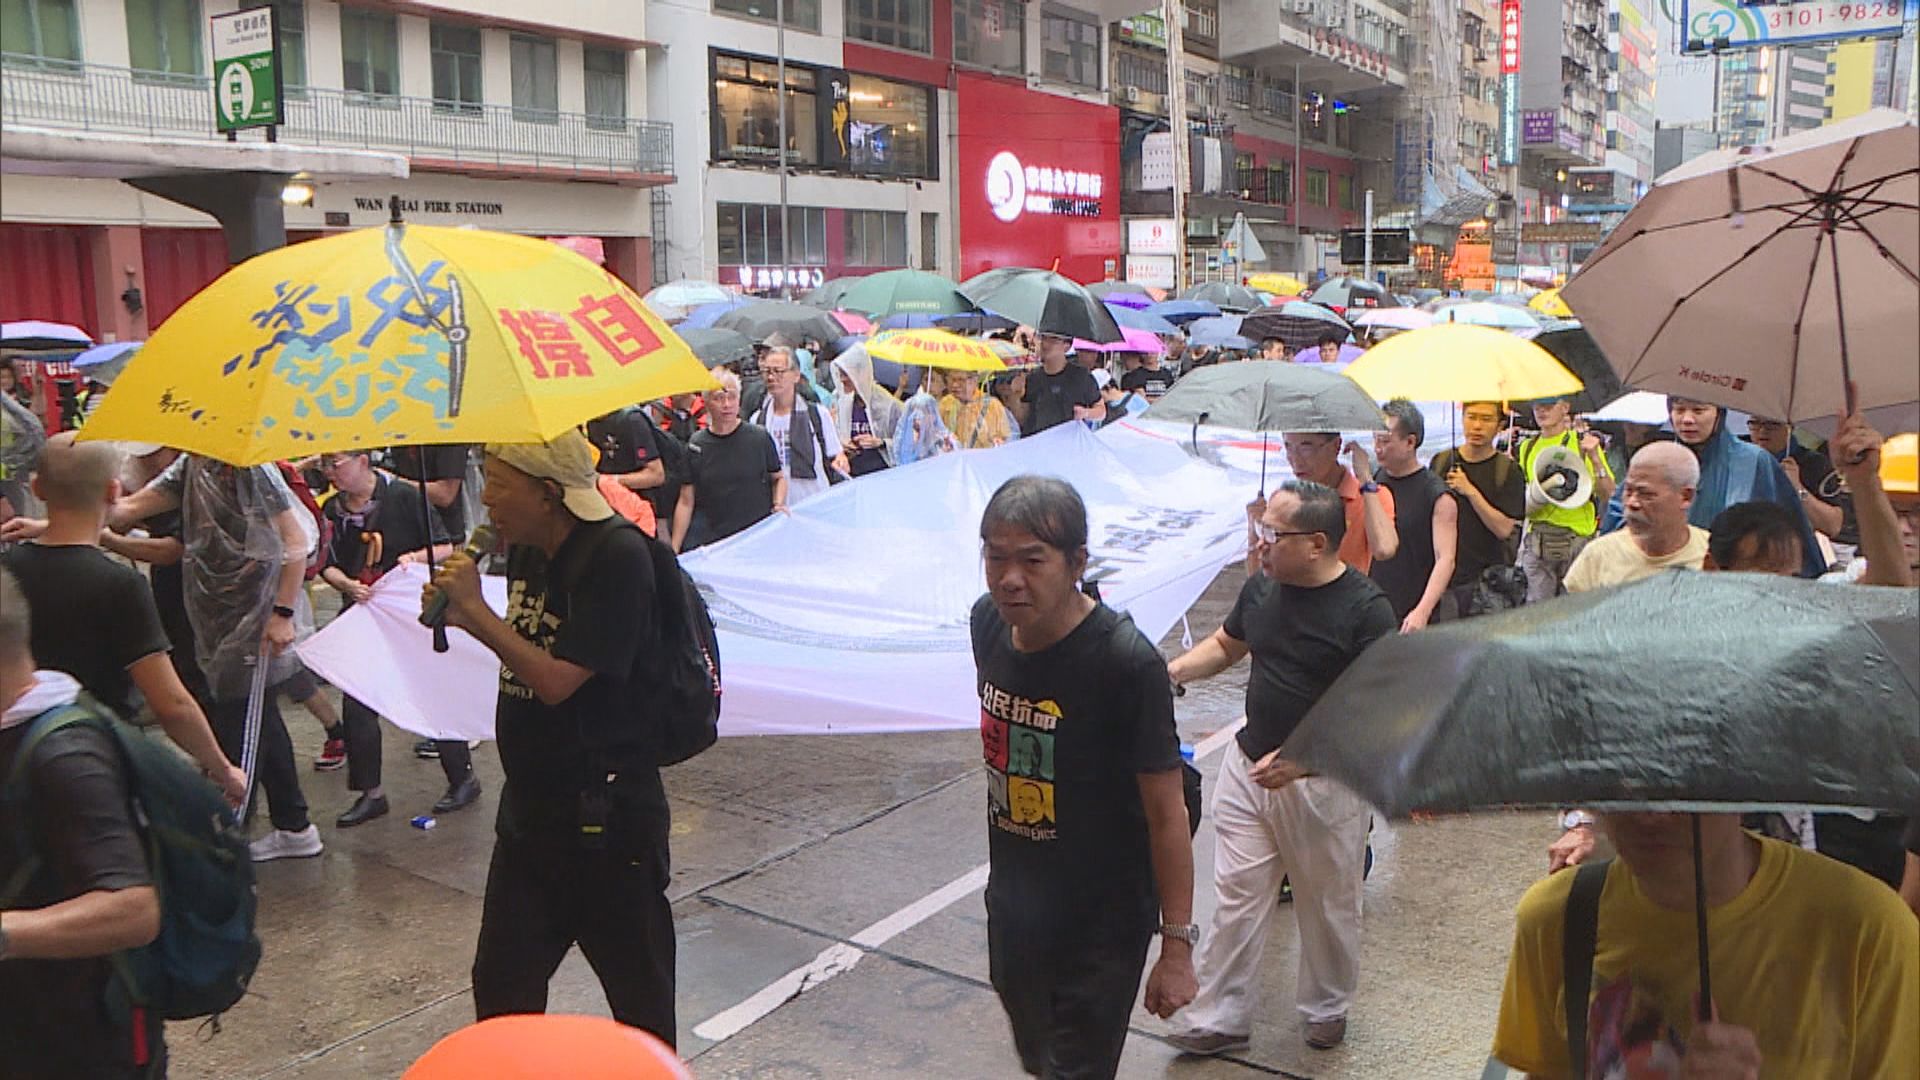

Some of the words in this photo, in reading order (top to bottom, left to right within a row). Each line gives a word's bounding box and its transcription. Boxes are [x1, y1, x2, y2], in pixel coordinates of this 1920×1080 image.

[1769, 0, 1898, 29] 3101-9828
[354, 198, 383, 211] WAN
[389, 199, 418, 212] HAI
[424, 201, 451, 213] FIRE
[456, 202, 502, 214] STATION
